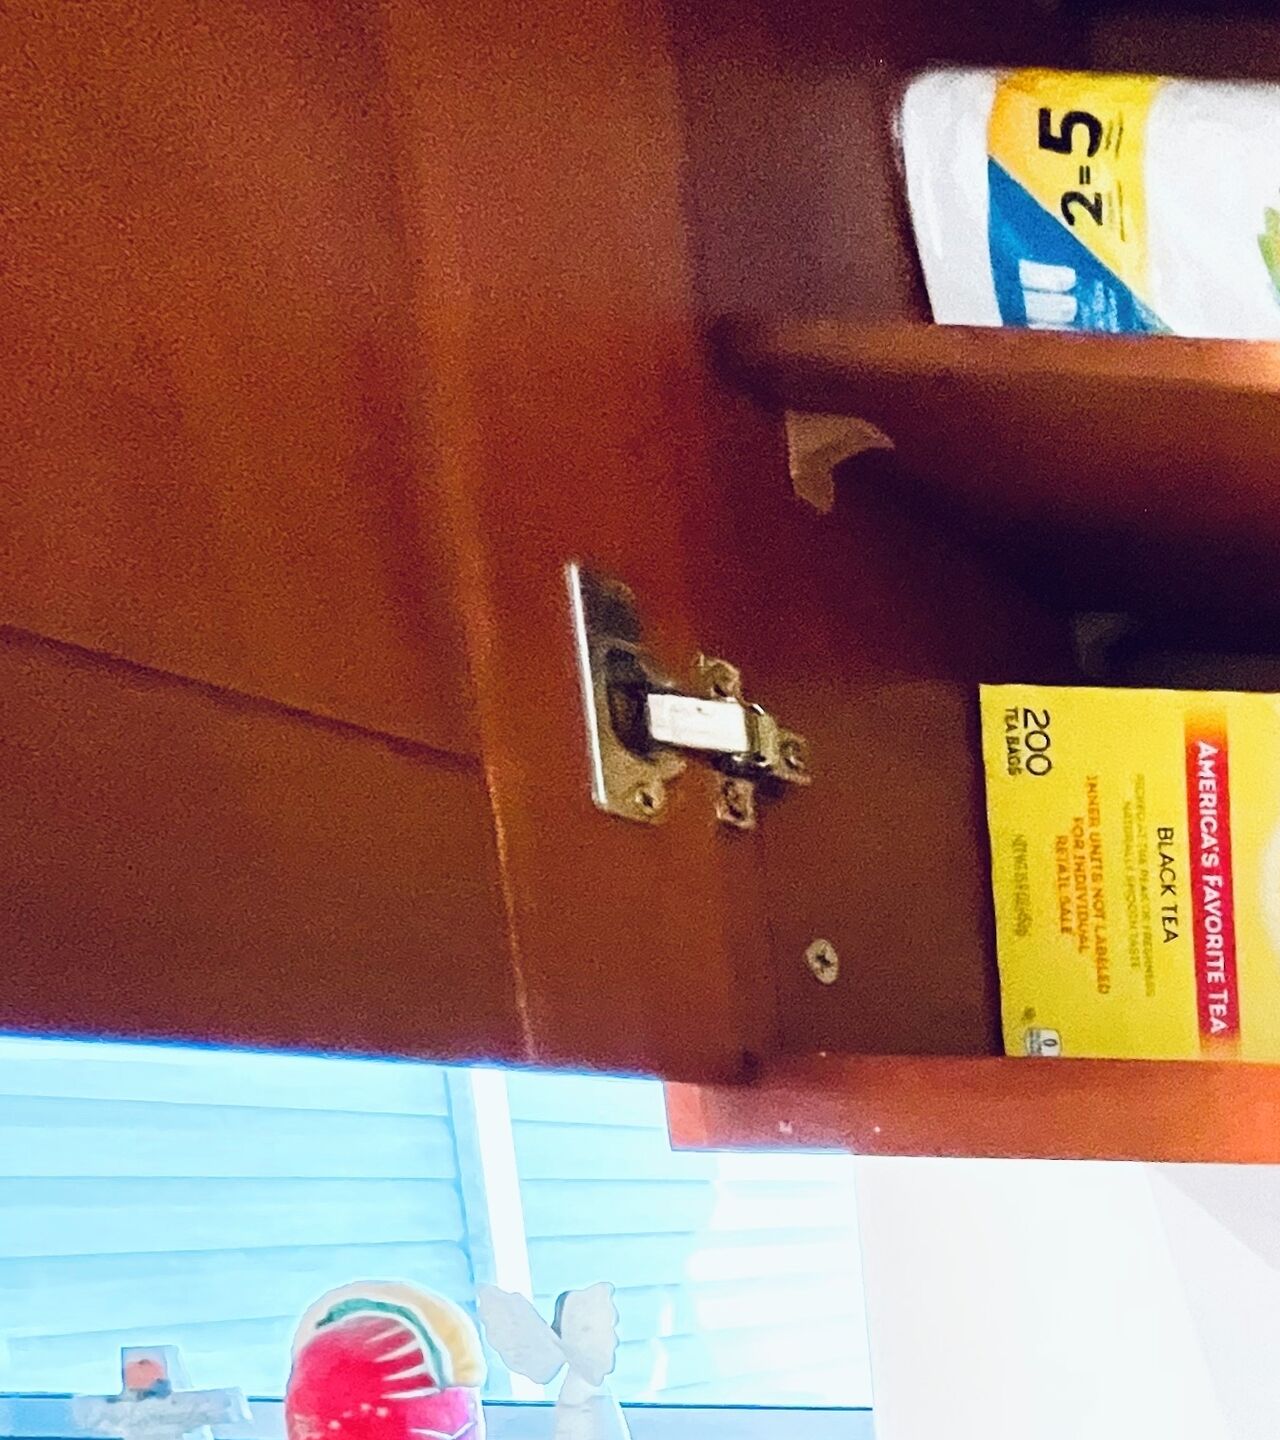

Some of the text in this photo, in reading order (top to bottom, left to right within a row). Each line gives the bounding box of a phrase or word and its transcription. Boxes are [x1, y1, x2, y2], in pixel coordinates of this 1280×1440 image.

[1004, 706, 1022, 776] TEA BAGS
[1024, 708, 1053, 776] 200
[1092, 888, 1107, 920] NOT
[1157, 827, 1179, 943] BLACK TEA
[1196, 742, 1229, 1034] AMERICA'S FAVORITE TEA
